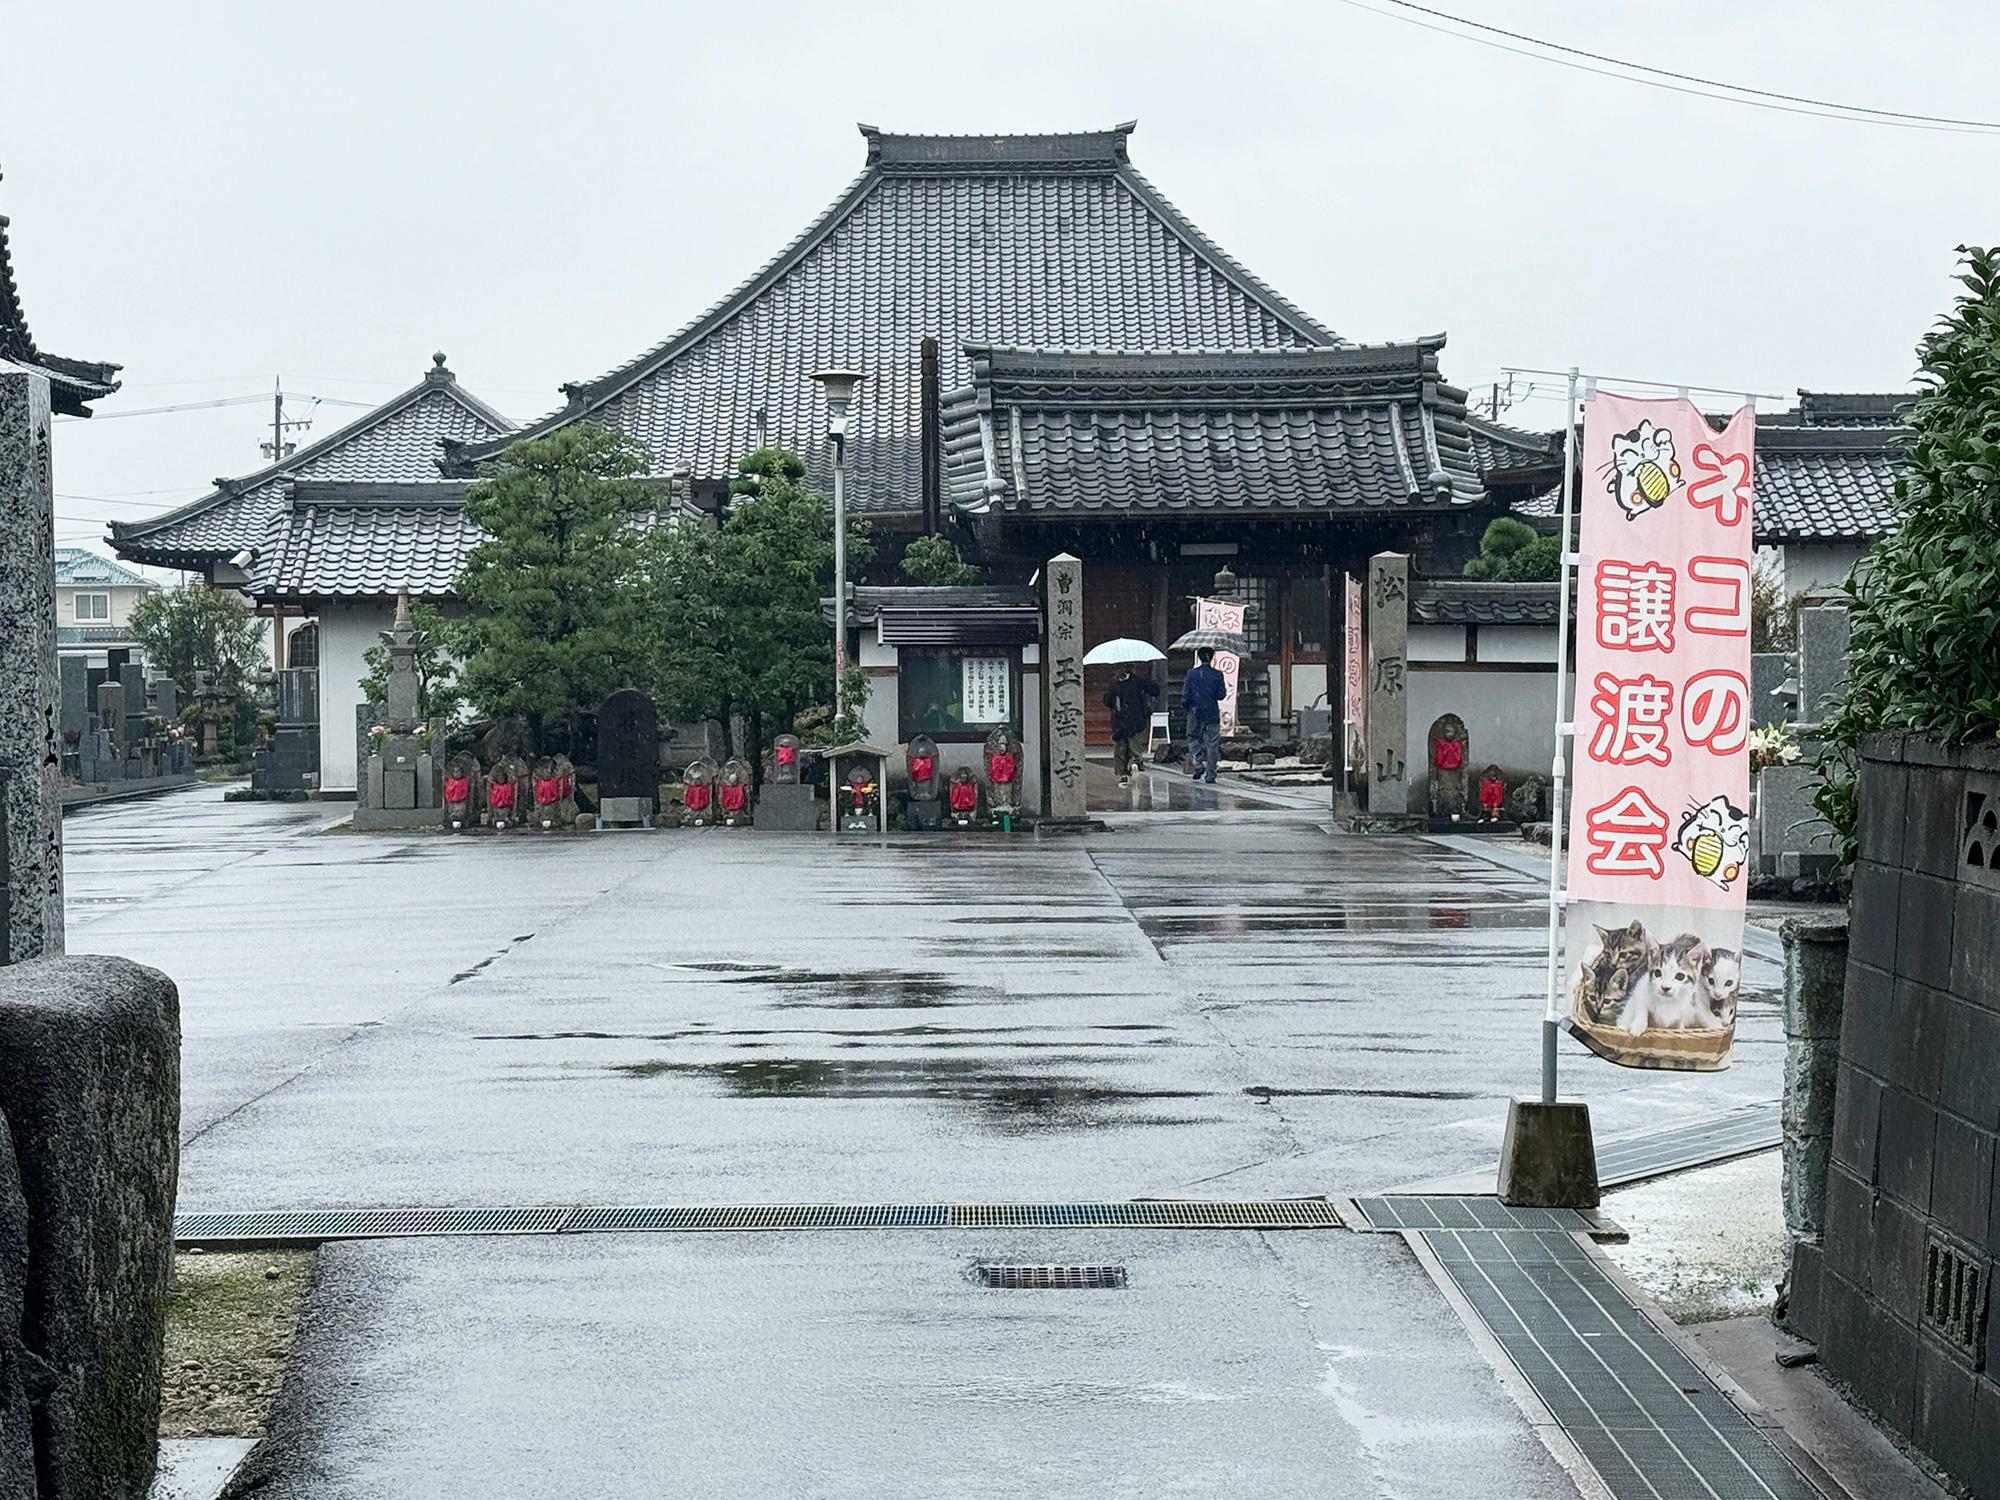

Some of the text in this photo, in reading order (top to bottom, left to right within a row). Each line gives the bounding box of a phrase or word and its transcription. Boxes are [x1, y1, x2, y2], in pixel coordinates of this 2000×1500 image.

[1373, 567, 1405, 783] 松原山
[1586, 559, 1676, 880] 譲渡会
[1679, 444, 1751, 756] ネコの
